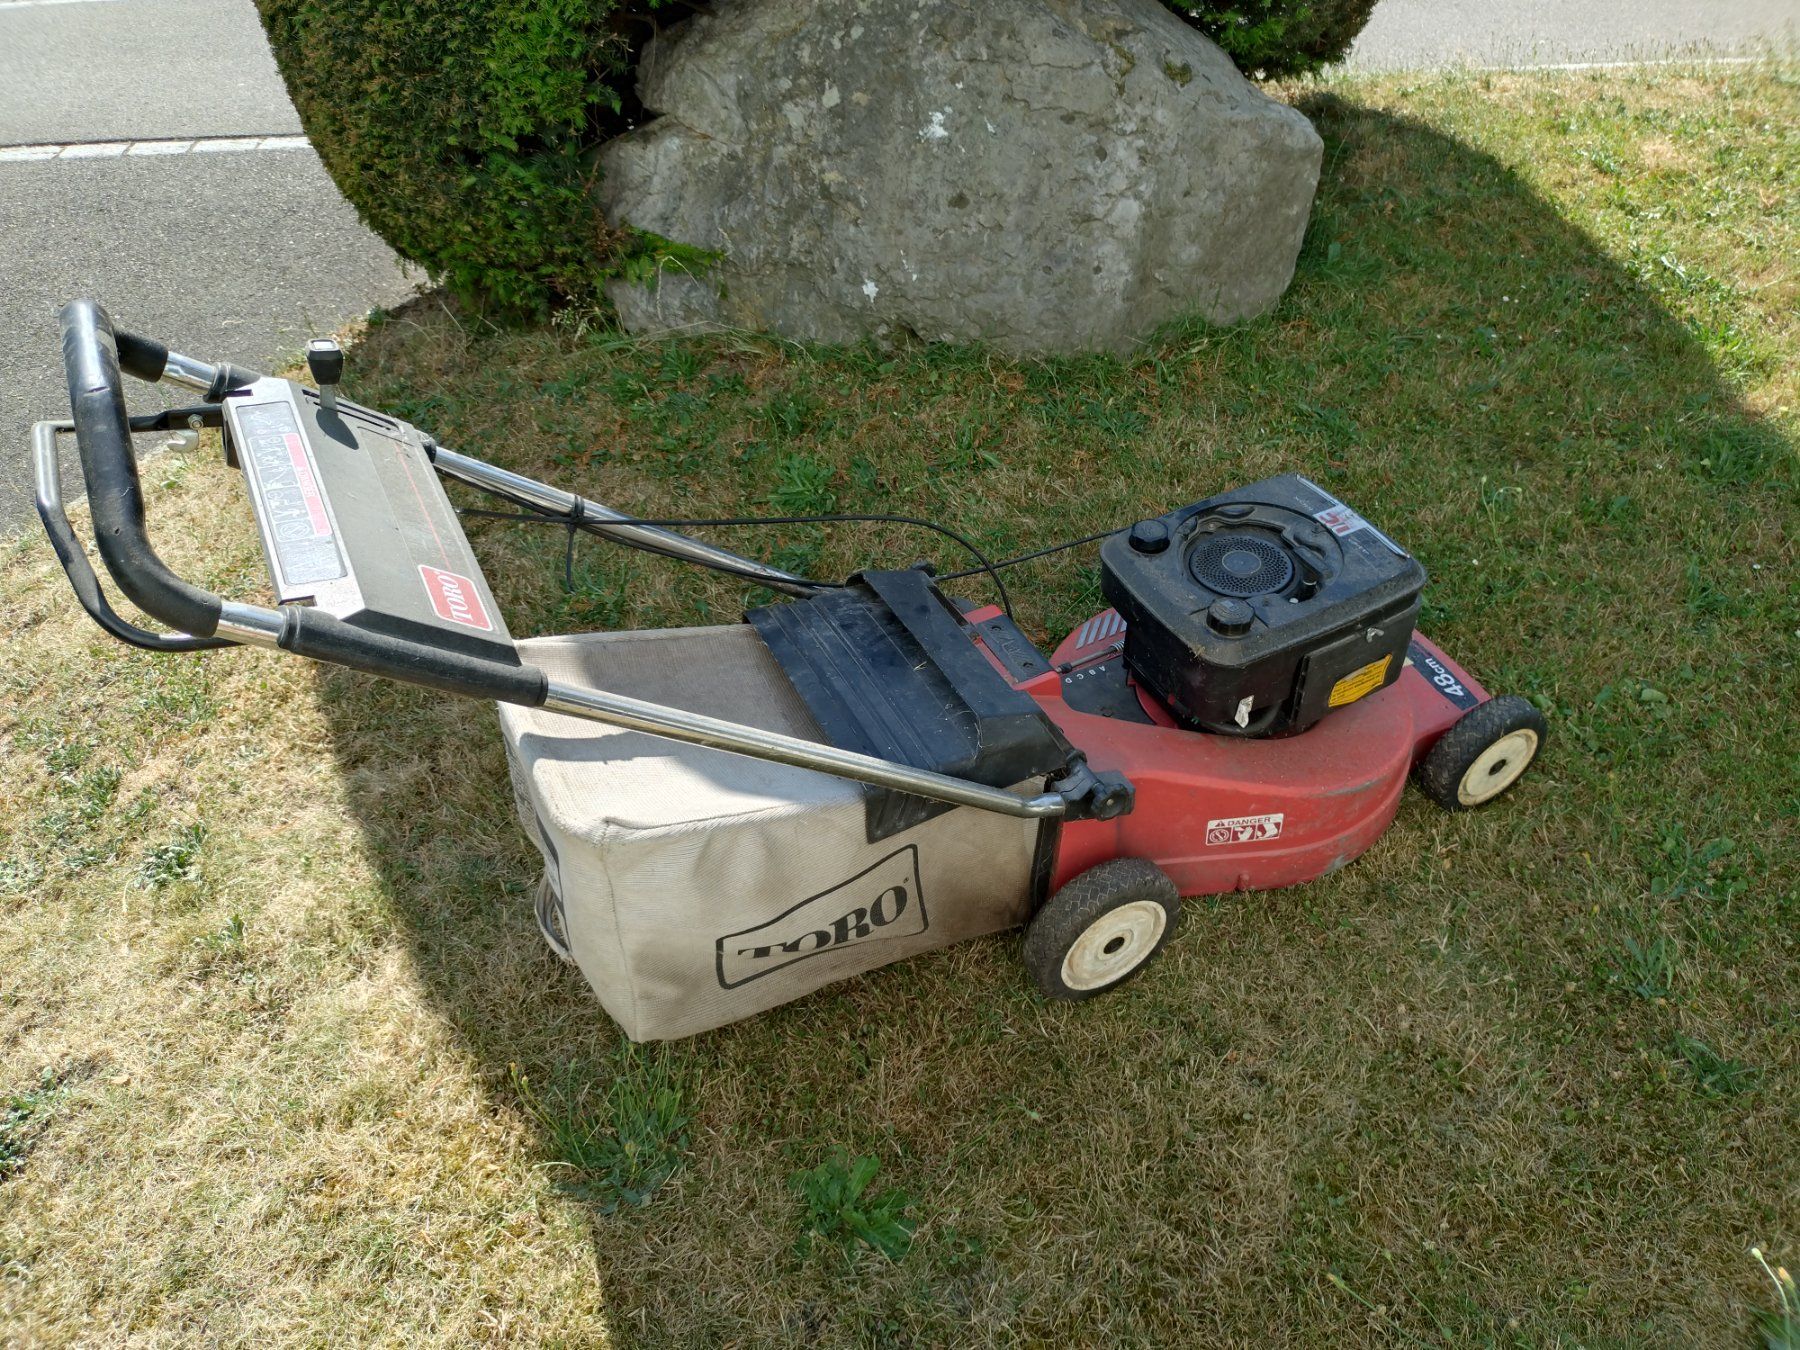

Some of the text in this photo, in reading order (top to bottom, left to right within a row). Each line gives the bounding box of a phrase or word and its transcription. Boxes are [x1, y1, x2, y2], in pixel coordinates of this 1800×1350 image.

[437, 574, 474, 622] TORO
[1425, 657, 1465, 697] 48cm
[1227, 816, 1271, 827] DANGER
[737, 885, 908, 959] TORO
